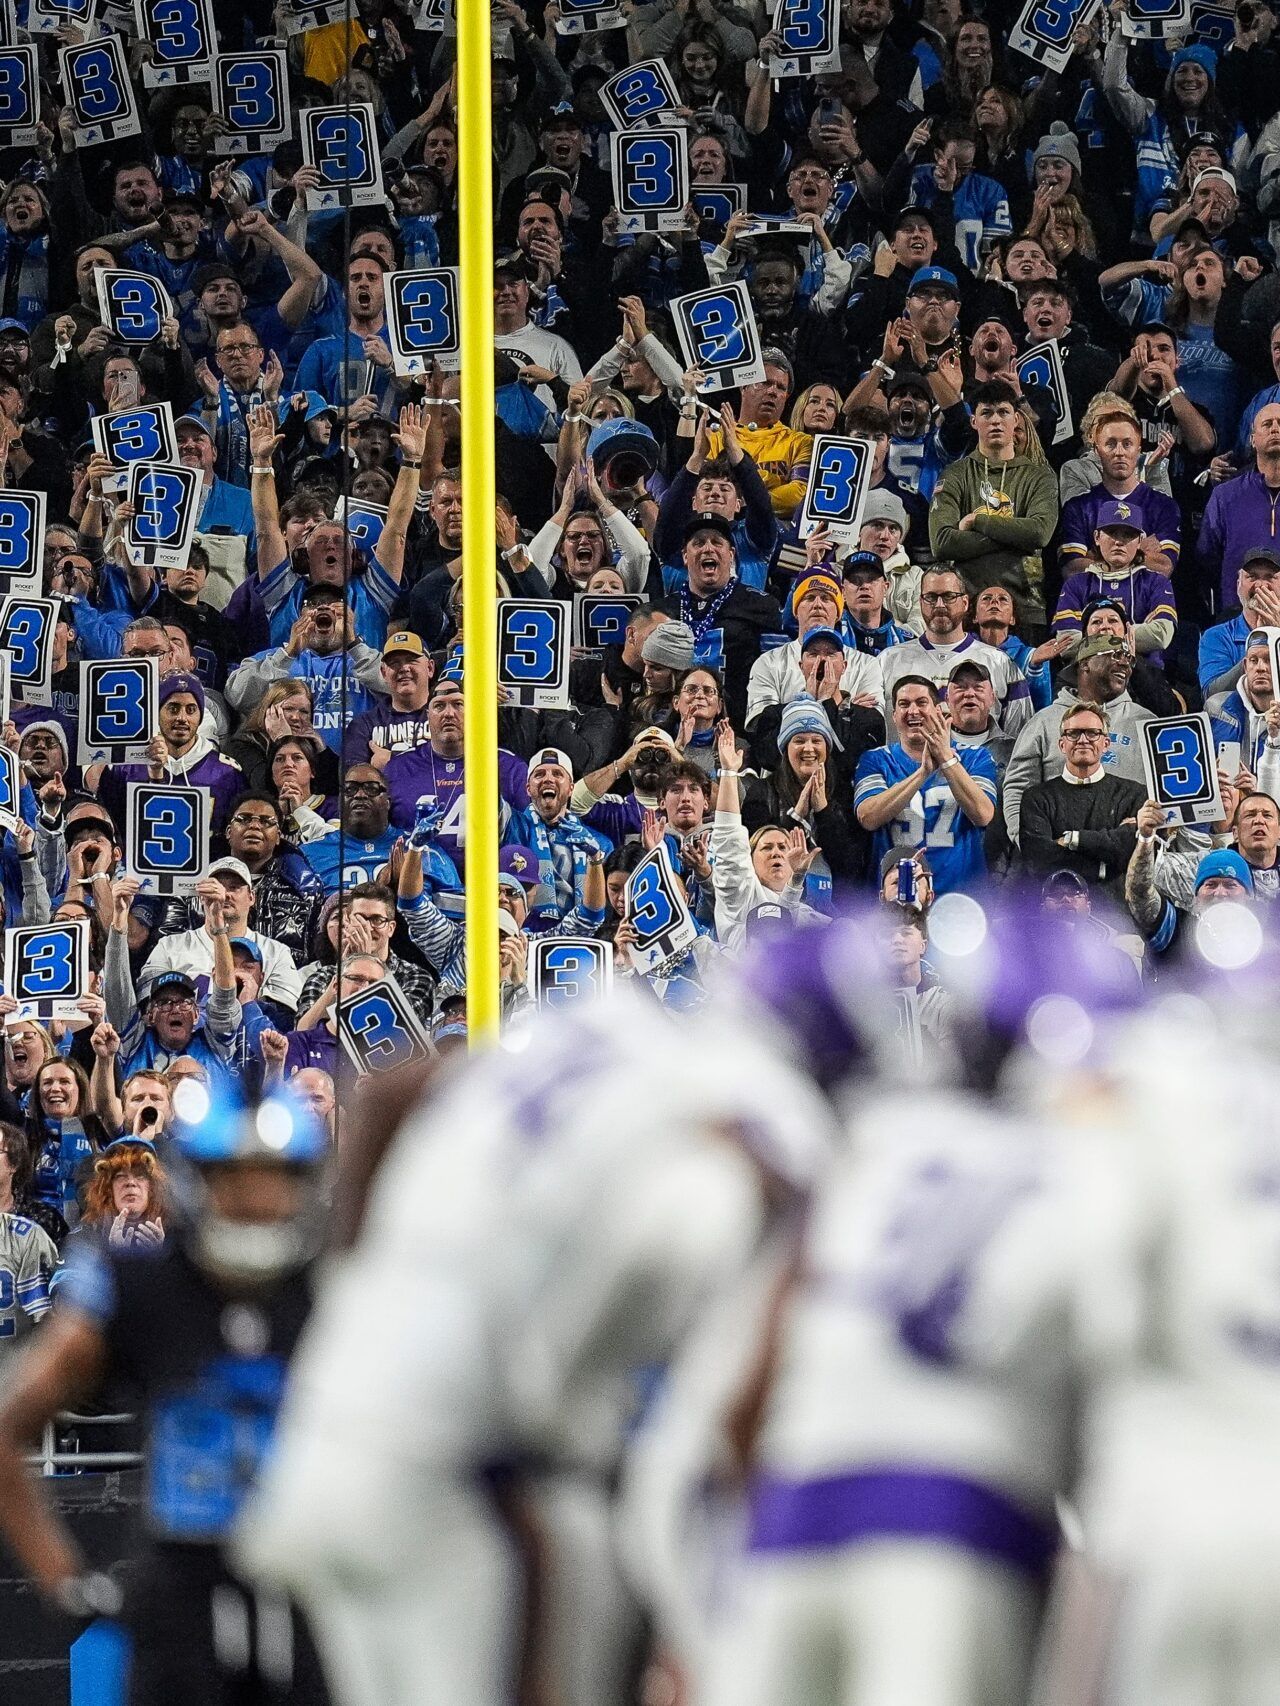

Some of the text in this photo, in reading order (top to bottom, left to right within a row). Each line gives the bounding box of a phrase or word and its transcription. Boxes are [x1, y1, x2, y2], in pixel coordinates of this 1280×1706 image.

[154, 0, 200, 58] 3
[785, 0, 824, 48] 3
[1034, 0, 1080, 40] 3
[74, 50, 122, 117] 3
[229, 63, 273, 125] 3
[617, 70, 666, 116] 3
[319, 117, 365, 179] 3
[627, 140, 673, 205] 3
[112, 278, 159, 340] 3
[402, 280, 449, 347] 3
[690, 296, 744, 363] 3
[501, 350, 526, 360] TROIT
[738, 370, 756, 378] ROCKET
[111, 411, 161, 462] 3
[135, 473, 184, 539] 3
[813, 447, 858, 514] 3
[0, 500, 31, 568] 3
[7, 608, 44, 677] 3
[505, 610, 556, 679] 3
[97, 670, 144, 737] 3
[294, 675, 361, 694] TROIT
[312, 711, 354, 730] ONS
[372, 720, 432, 748] MINNESO
[1156, 726, 1204, 798] 3
[143, 795, 193, 867] 3
[631, 863, 672, 935] 3
[22, 932, 72, 994] 3
[546, 946, 597, 1010] 3
